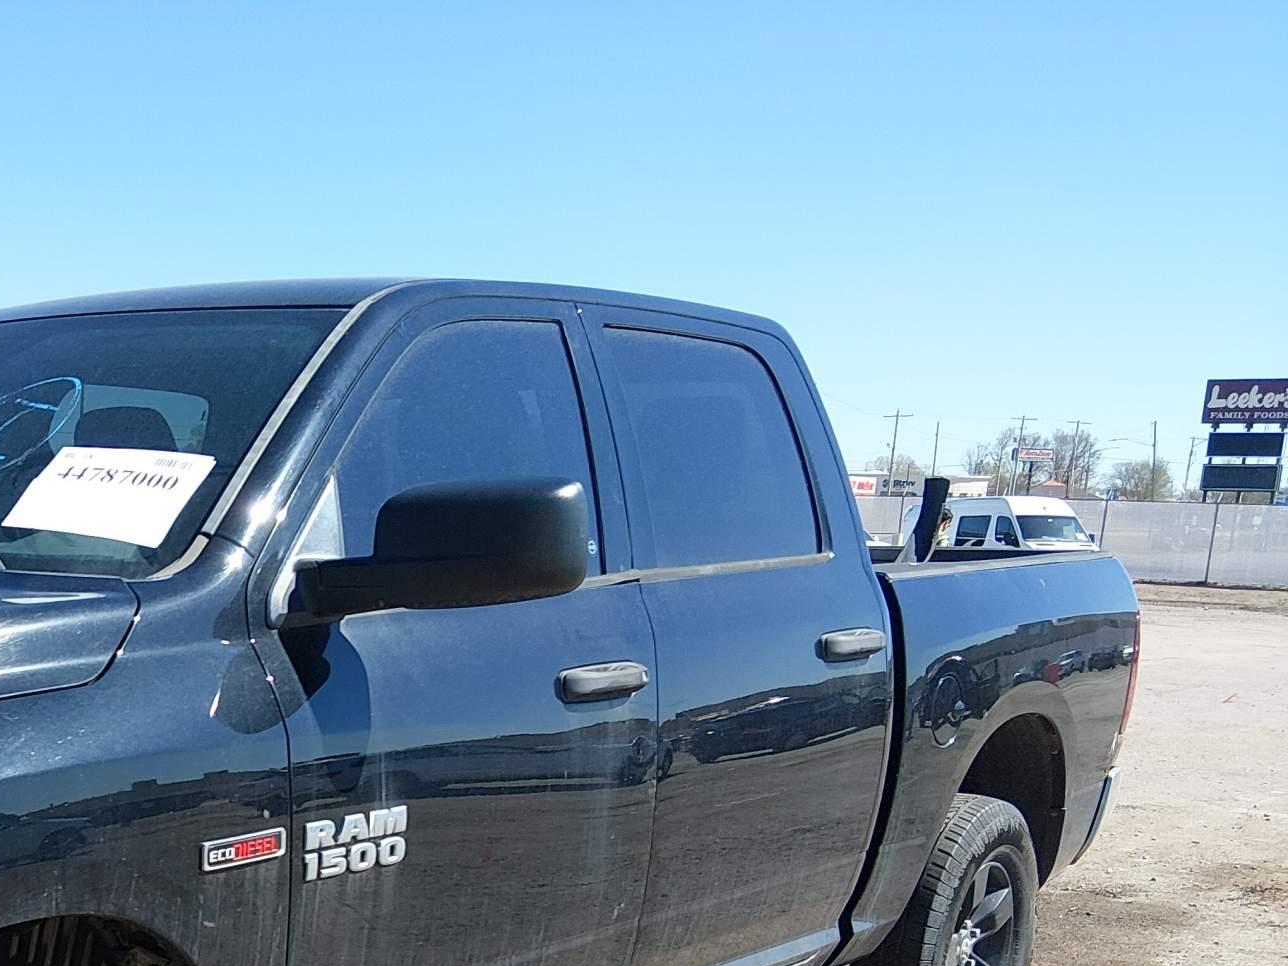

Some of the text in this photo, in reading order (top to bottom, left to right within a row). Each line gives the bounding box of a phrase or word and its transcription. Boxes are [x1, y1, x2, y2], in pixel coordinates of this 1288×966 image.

[1210, 411, 1251, 419] FAMILY
[57, 465, 179, 491] 44787000
[304, 804, 408, 851] RAM
[303, 835, 407, 882] 1500
